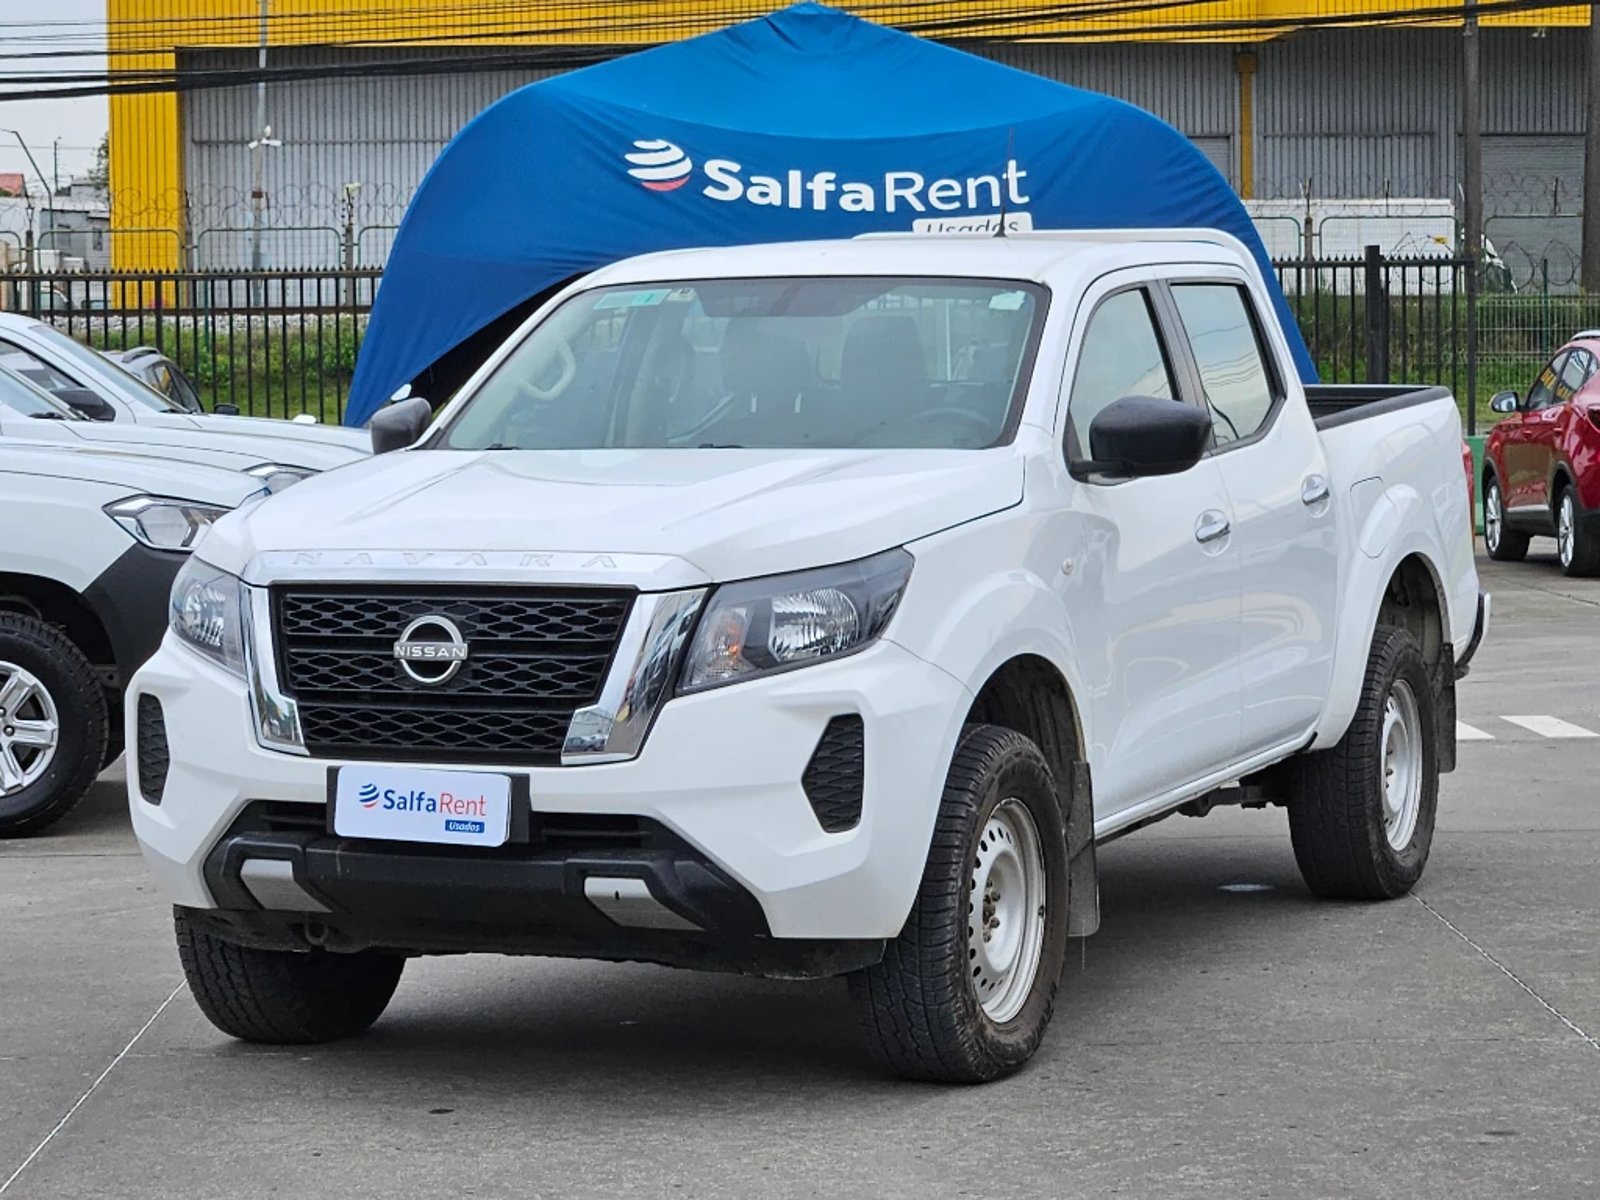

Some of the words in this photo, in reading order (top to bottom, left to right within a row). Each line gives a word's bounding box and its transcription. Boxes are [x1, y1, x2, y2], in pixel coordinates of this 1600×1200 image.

[703, 159, 1030, 212] SalfaRent
[292, 551, 619, 569] NAVARA
[395, 646, 465, 657] NISSAN
[382, 788, 487, 816] SalfaRent
[449, 821, 481, 831] Usados
